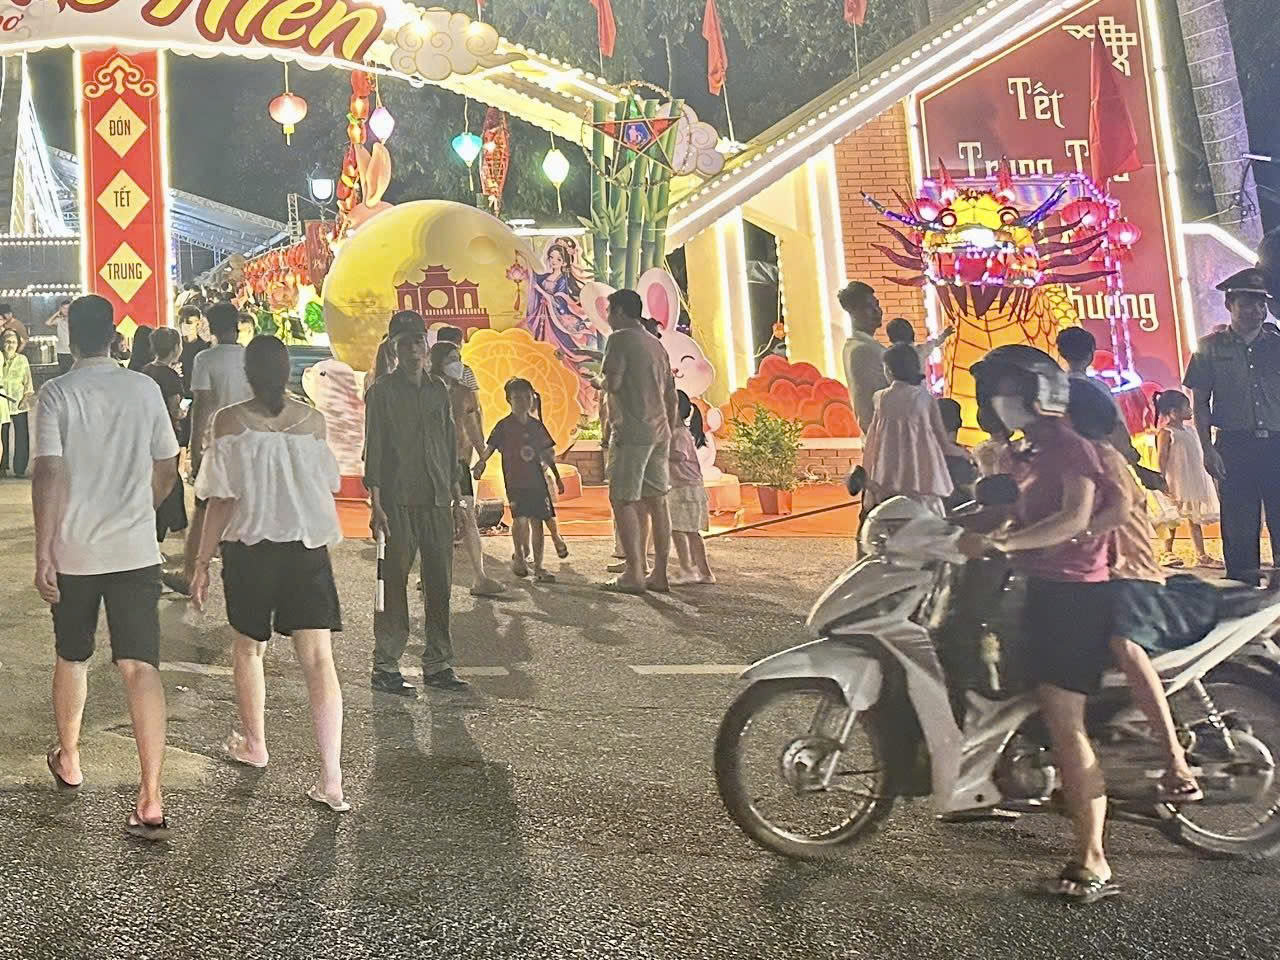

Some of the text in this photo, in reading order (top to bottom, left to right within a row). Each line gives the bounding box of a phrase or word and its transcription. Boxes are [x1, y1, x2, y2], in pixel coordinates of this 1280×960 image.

[1007, 77, 1065, 128] Tết
[109, 116, 131, 136] ĐÓN
[113, 186, 131, 207] TẾT
[106, 262, 143, 281] TRUNG
[1061, 282, 1160, 332] hương
